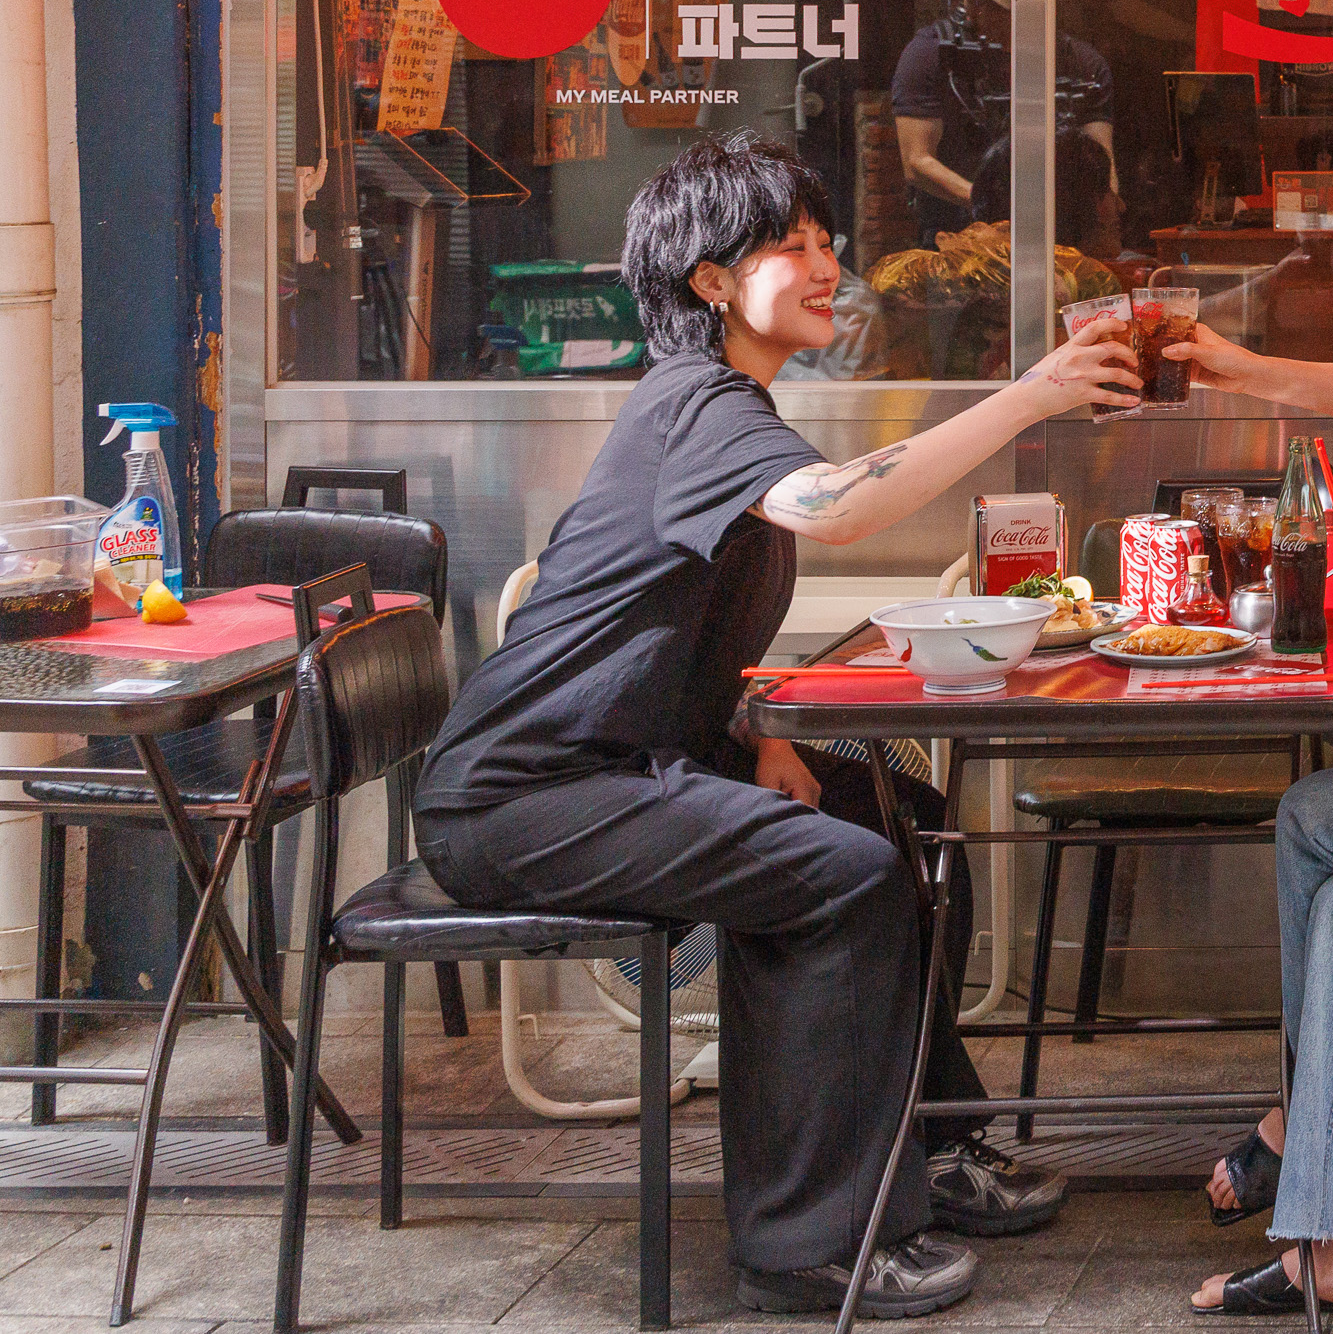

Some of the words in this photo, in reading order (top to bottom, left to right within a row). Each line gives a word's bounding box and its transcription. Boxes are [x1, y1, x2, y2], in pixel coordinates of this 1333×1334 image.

[678, 3, 860, 60] 파트너
[556, 90, 585, 104] MY
[590, 90, 644, 104] MEAL
[650, 90, 739, 104] PARTNER
[100, 528, 158, 552] GLASS
[990, 526, 1050, 547] Coca-Cola
[109, 543, 156, 559] CLEANER
